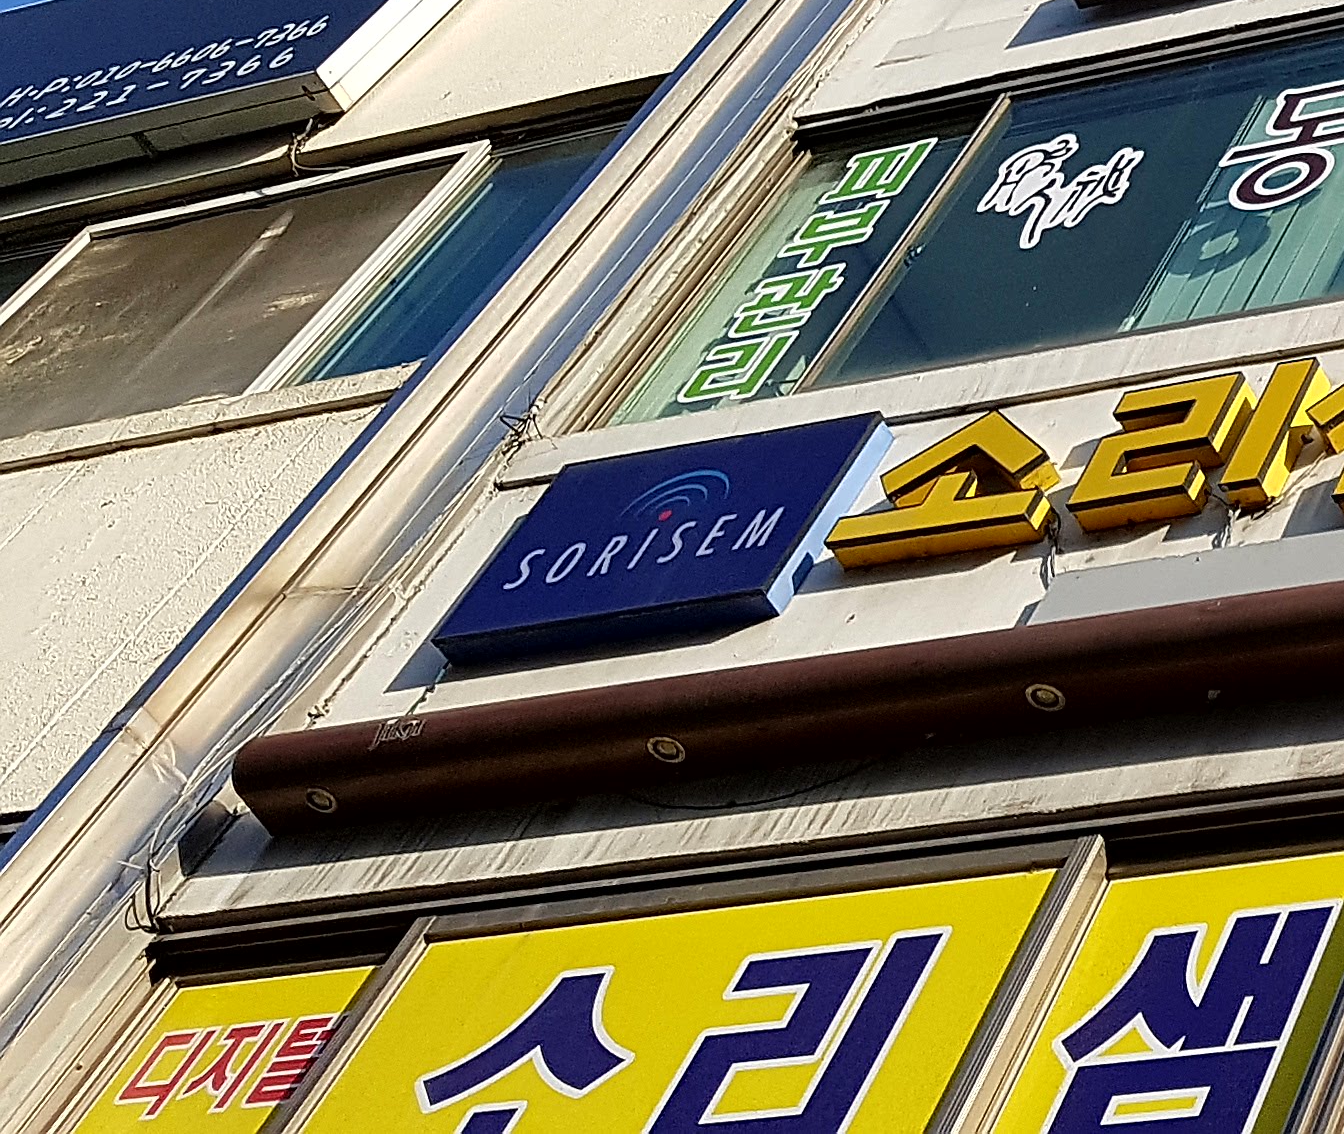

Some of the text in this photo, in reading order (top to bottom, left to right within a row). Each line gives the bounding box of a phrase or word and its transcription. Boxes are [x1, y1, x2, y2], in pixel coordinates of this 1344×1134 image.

[676, 137, 939, 404] 피부관리
[502, 506, 786, 591] SORISEM
[416, 897, 1344, 1134] 소리샘
